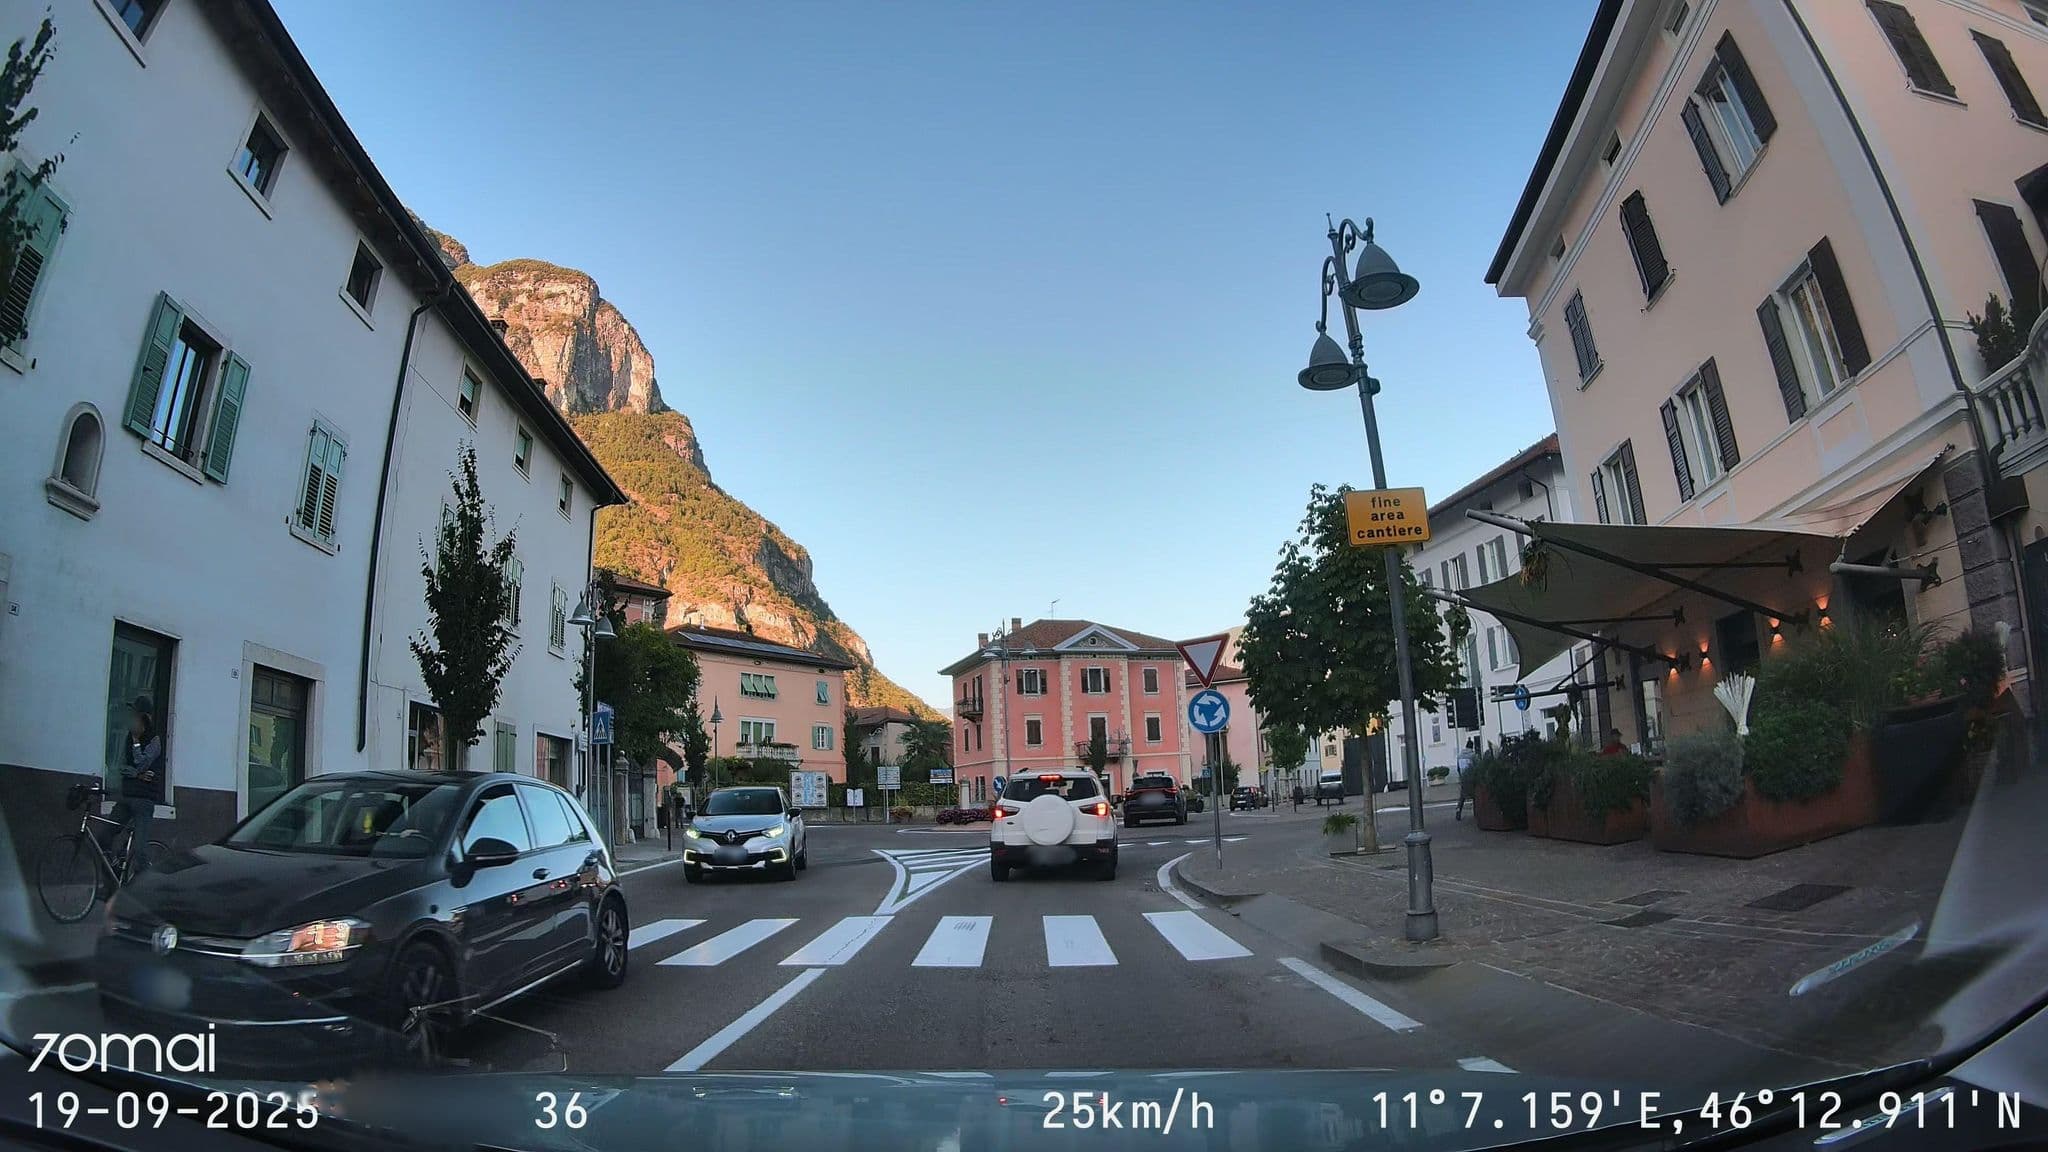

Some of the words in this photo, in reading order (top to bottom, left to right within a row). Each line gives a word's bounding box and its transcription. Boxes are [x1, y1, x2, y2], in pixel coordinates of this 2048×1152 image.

[1371, 497, 1401, 508] fine
[1371, 511, 1405, 521] area
[1357, 525, 1423, 539] cantiere
